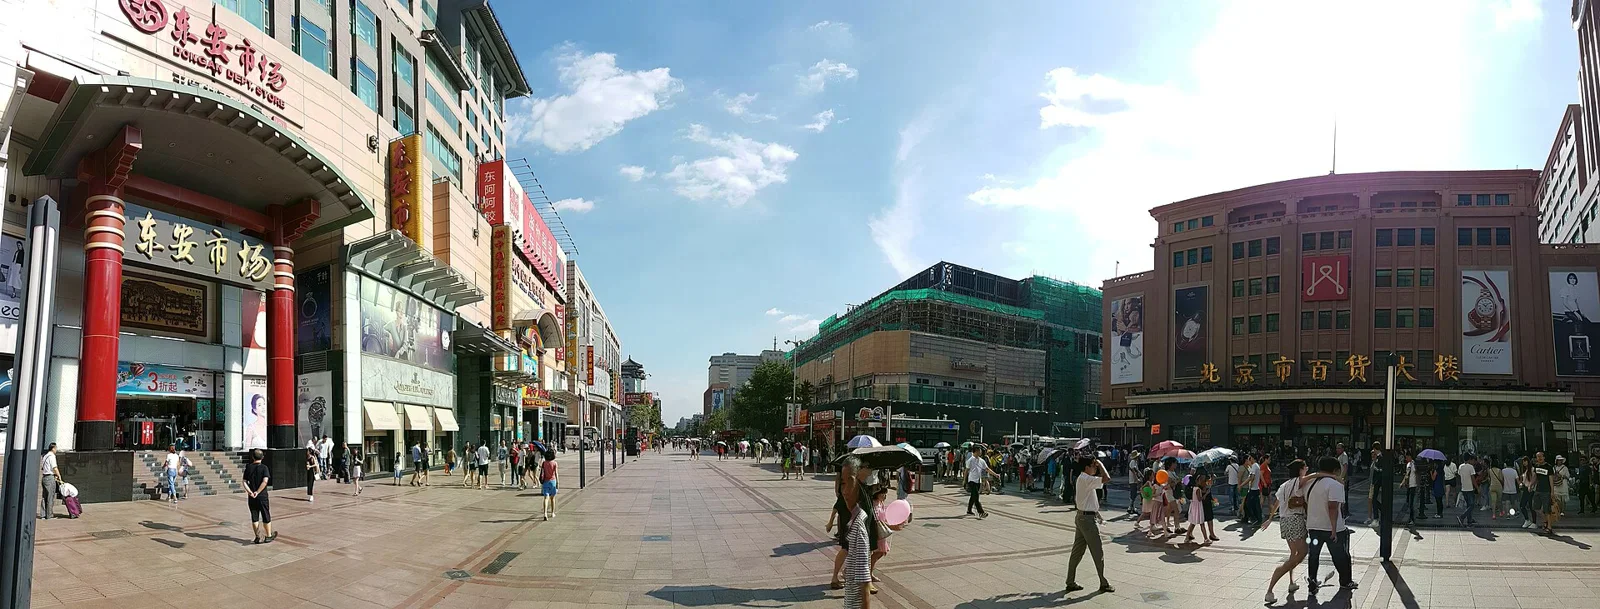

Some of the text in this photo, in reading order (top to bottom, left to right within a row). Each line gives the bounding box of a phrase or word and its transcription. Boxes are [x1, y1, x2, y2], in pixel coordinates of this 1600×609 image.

[171, 6, 288, 93] 东安市场
[173, 45, 222, 75] DONGAN
[255, 85, 287, 110] STORE
[391, 140, 413, 237] 东安市
[484, 171, 496, 222] 东阿阿胶
[135, 211, 273, 282] 东安市场
[1200, 354, 1461, 383] 北京市百货大楼
[1470, 344, 1504, 355] Cartier
